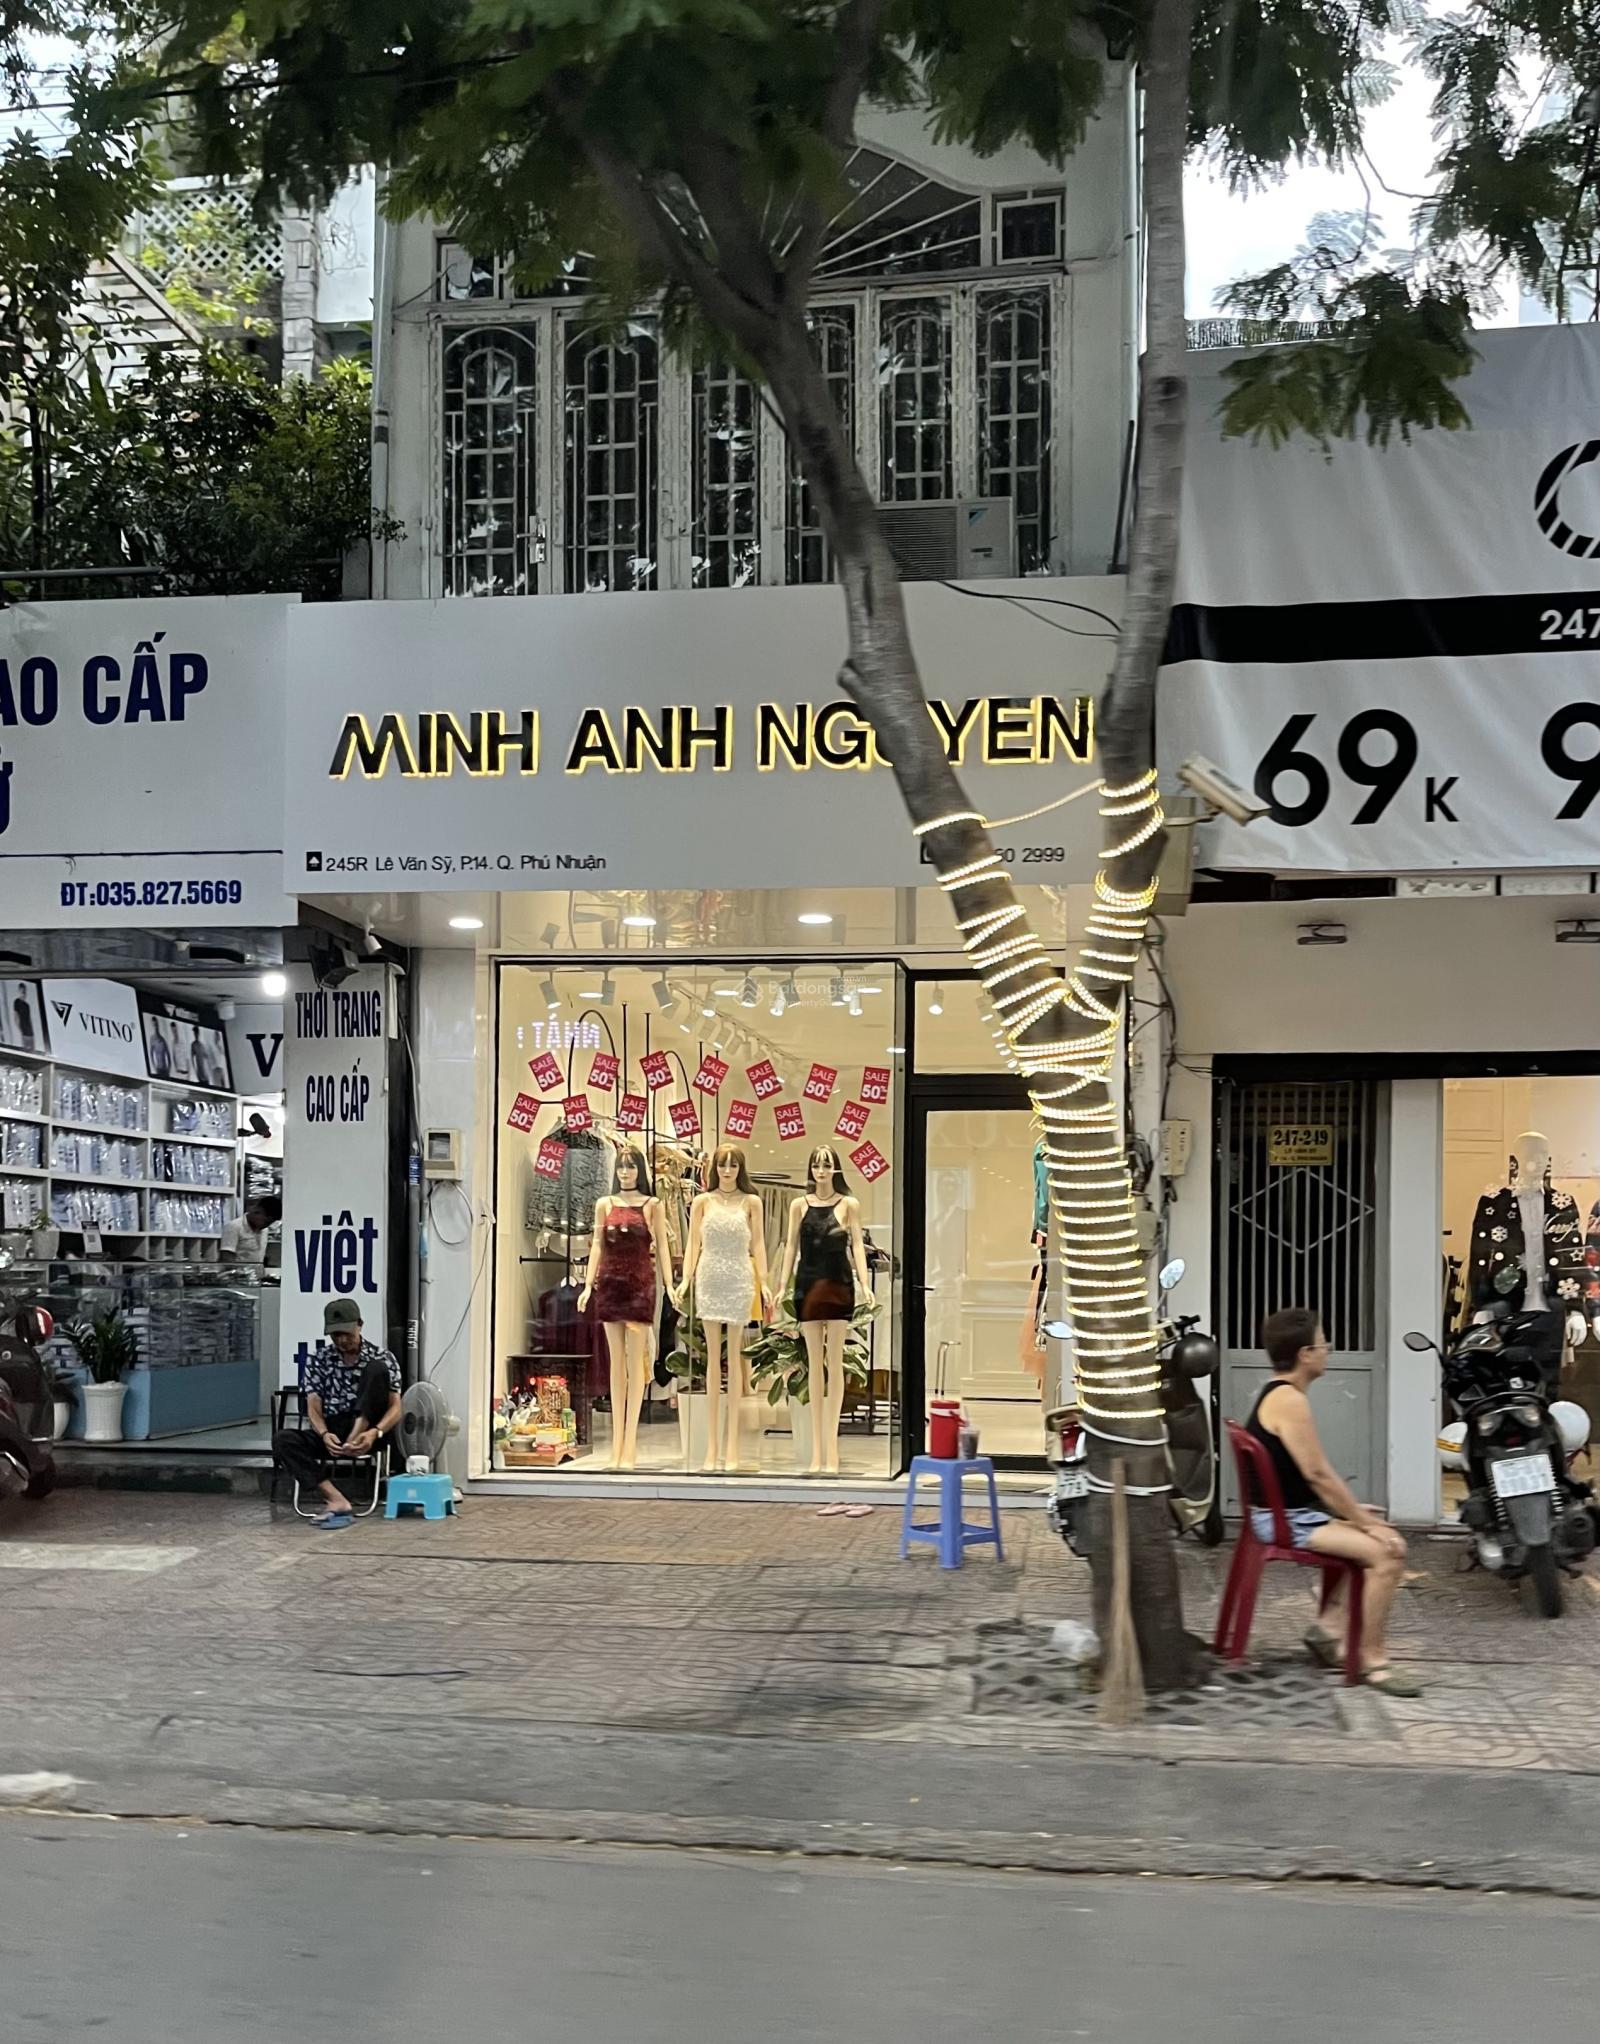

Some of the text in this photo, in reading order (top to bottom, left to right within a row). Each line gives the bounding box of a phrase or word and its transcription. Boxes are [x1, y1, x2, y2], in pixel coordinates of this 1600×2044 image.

[83, 631, 208, 724] CẤP
[329, 696, 1094, 780] MINH ANH NGYEN
[1022, 847, 1065, 862] 2999
[326, 856, 368, 872] 245R
[375, 856, 394, 871] Lê
[497, 855, 514, 870] Q.
[520, 855, 550, 870] Phú
[556, 855, 606, 872] Nhuận
[60, 879, 242, 906] ĐT:035.827.5669
[332, 990, 381, 1037] TRANG
[533, 1056, 555, 1072] SALE
[594, 1056, 618, 1071] SALE
[642, 1055, 665, 1071] SALE
[703, 1059, 726, 1076] SALE
[749, 1063, 772, 1081] SALE
[812, 1067, 836, 1082] SALE
[864, 1071, 889, 1083] SALE
[306, 1057, 369, 1122] CAO CẤP
[515, 1097, 539, 1112] SALE
[564, 1098, 587, 1111] SALE
[623, 1098, 647, 1111] SALE
[671, 1105, 694, 1119] SALE
[732, 1104, 756, 1118] SALE
[776, 1106, 800, 1120] SALE
[844, 1105, 868, 1121] SALE
[542, 1144, 566, 1158] SALE
[853, 1145, 876, 1165] SALE
